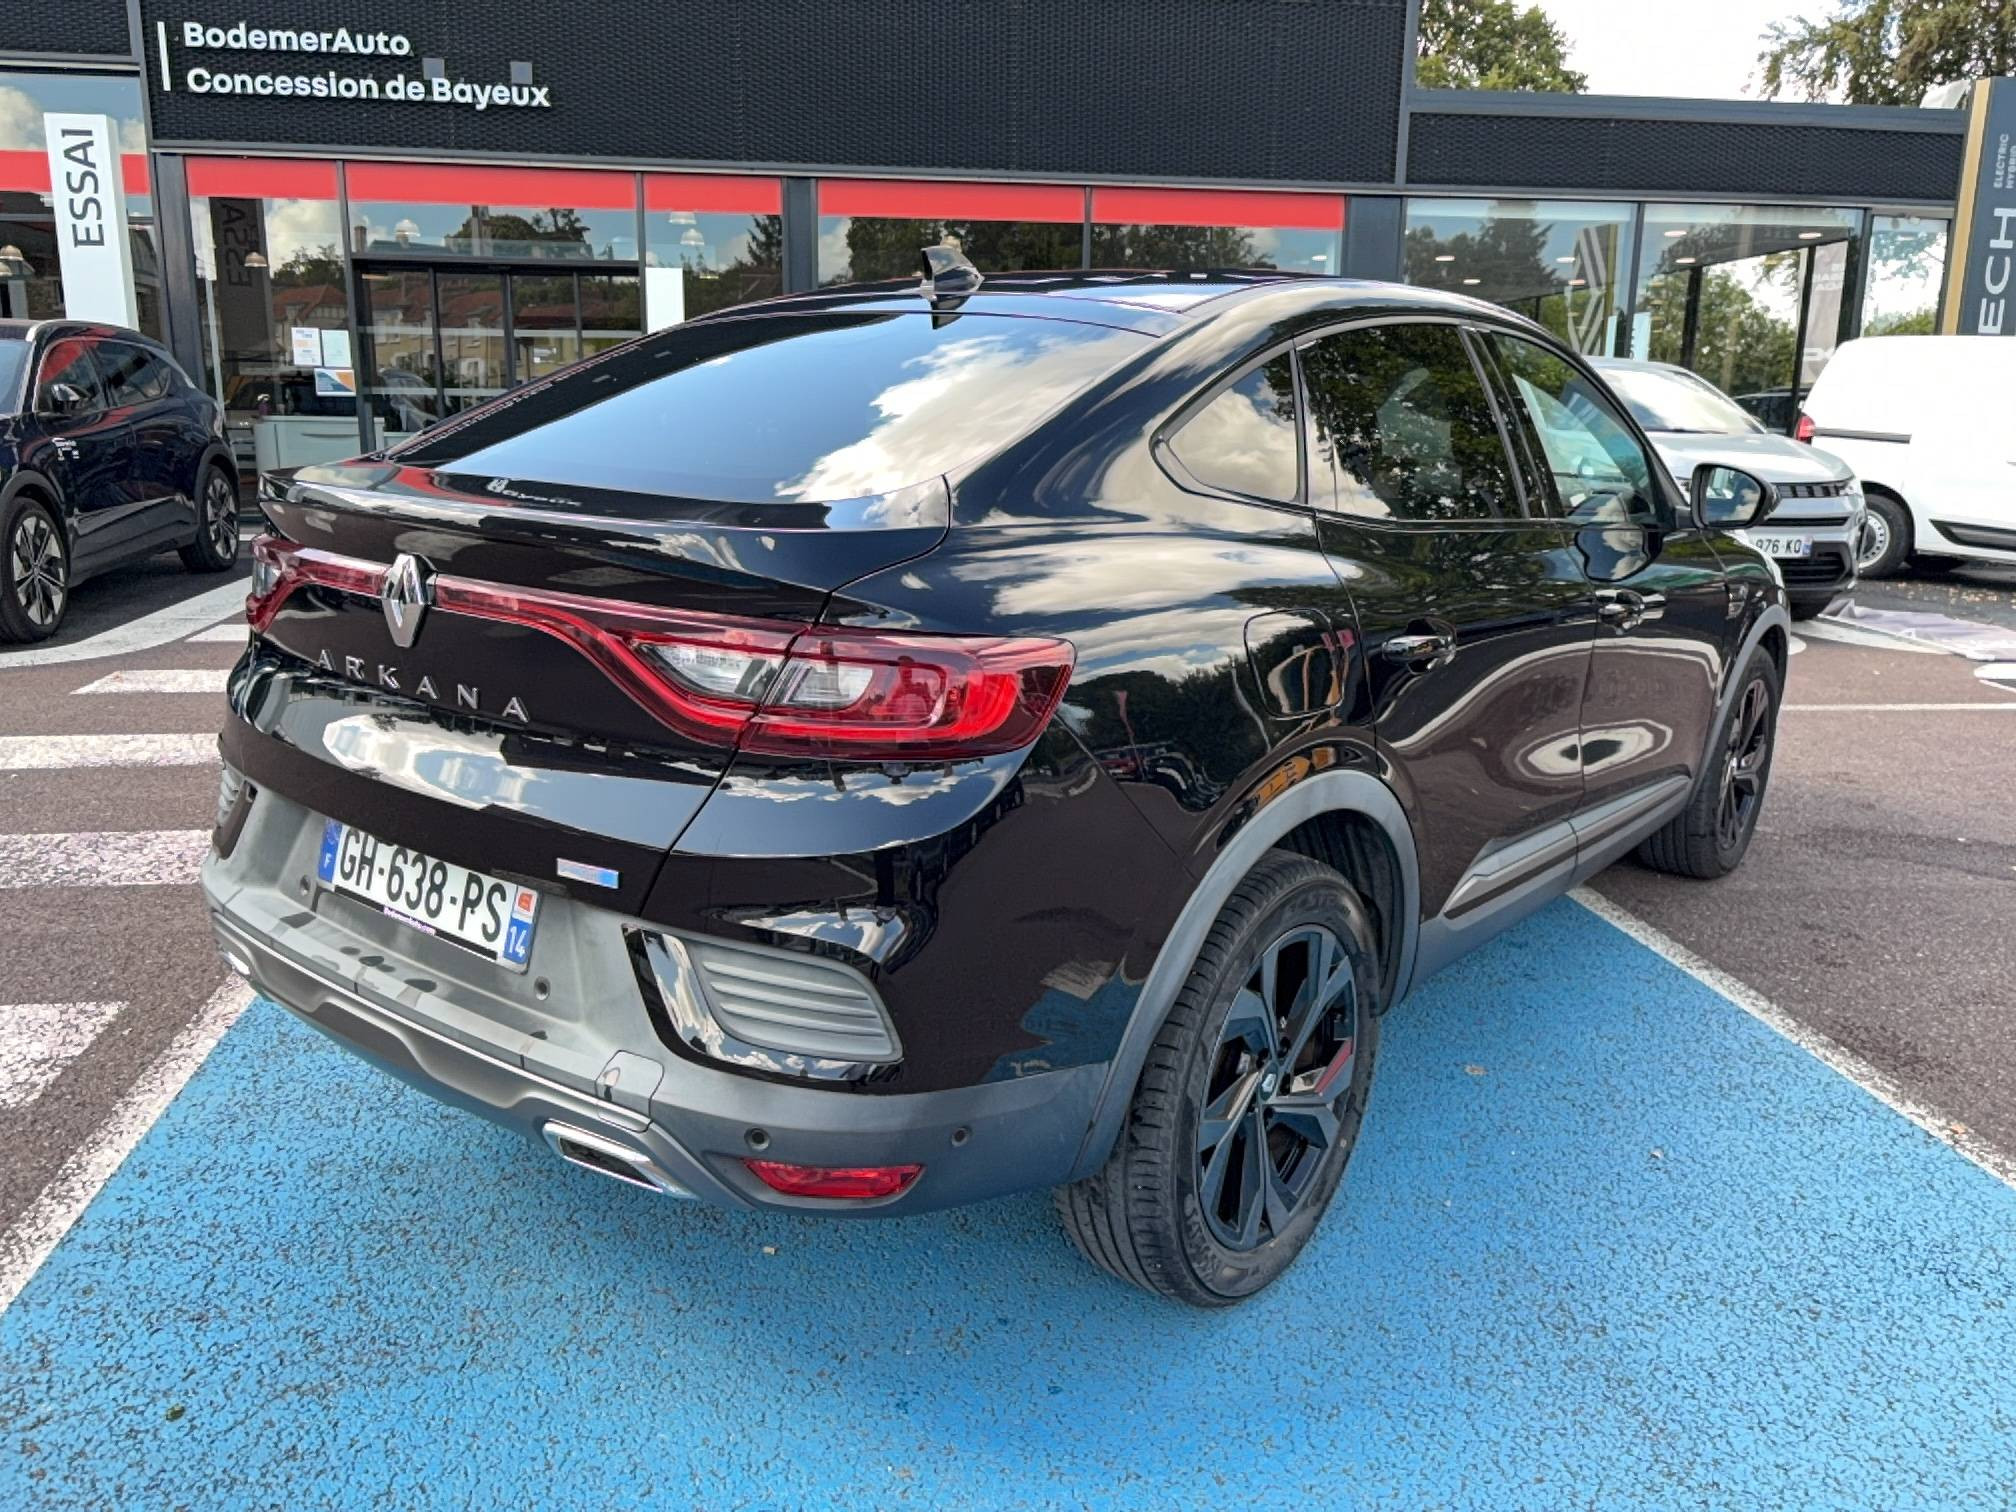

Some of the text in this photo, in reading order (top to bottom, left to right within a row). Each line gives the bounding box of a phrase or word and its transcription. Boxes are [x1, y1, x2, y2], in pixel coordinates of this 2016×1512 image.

[183, 21, 411, 56] BodemerAuto
[186, 67, 551, 110] Concession de Bayeux
[61, 128, 105, 248] ESSAI
[1992, 132, 2009, 188] ELECTRIC
[1978, 208, 2016, 334] ECH
[318, 649, 529, 723] ARKANA
[323, 853, 333, 868] F
[339, 829, 507, 942] GH-638-PS
[508, 926, 528, 956] 14
